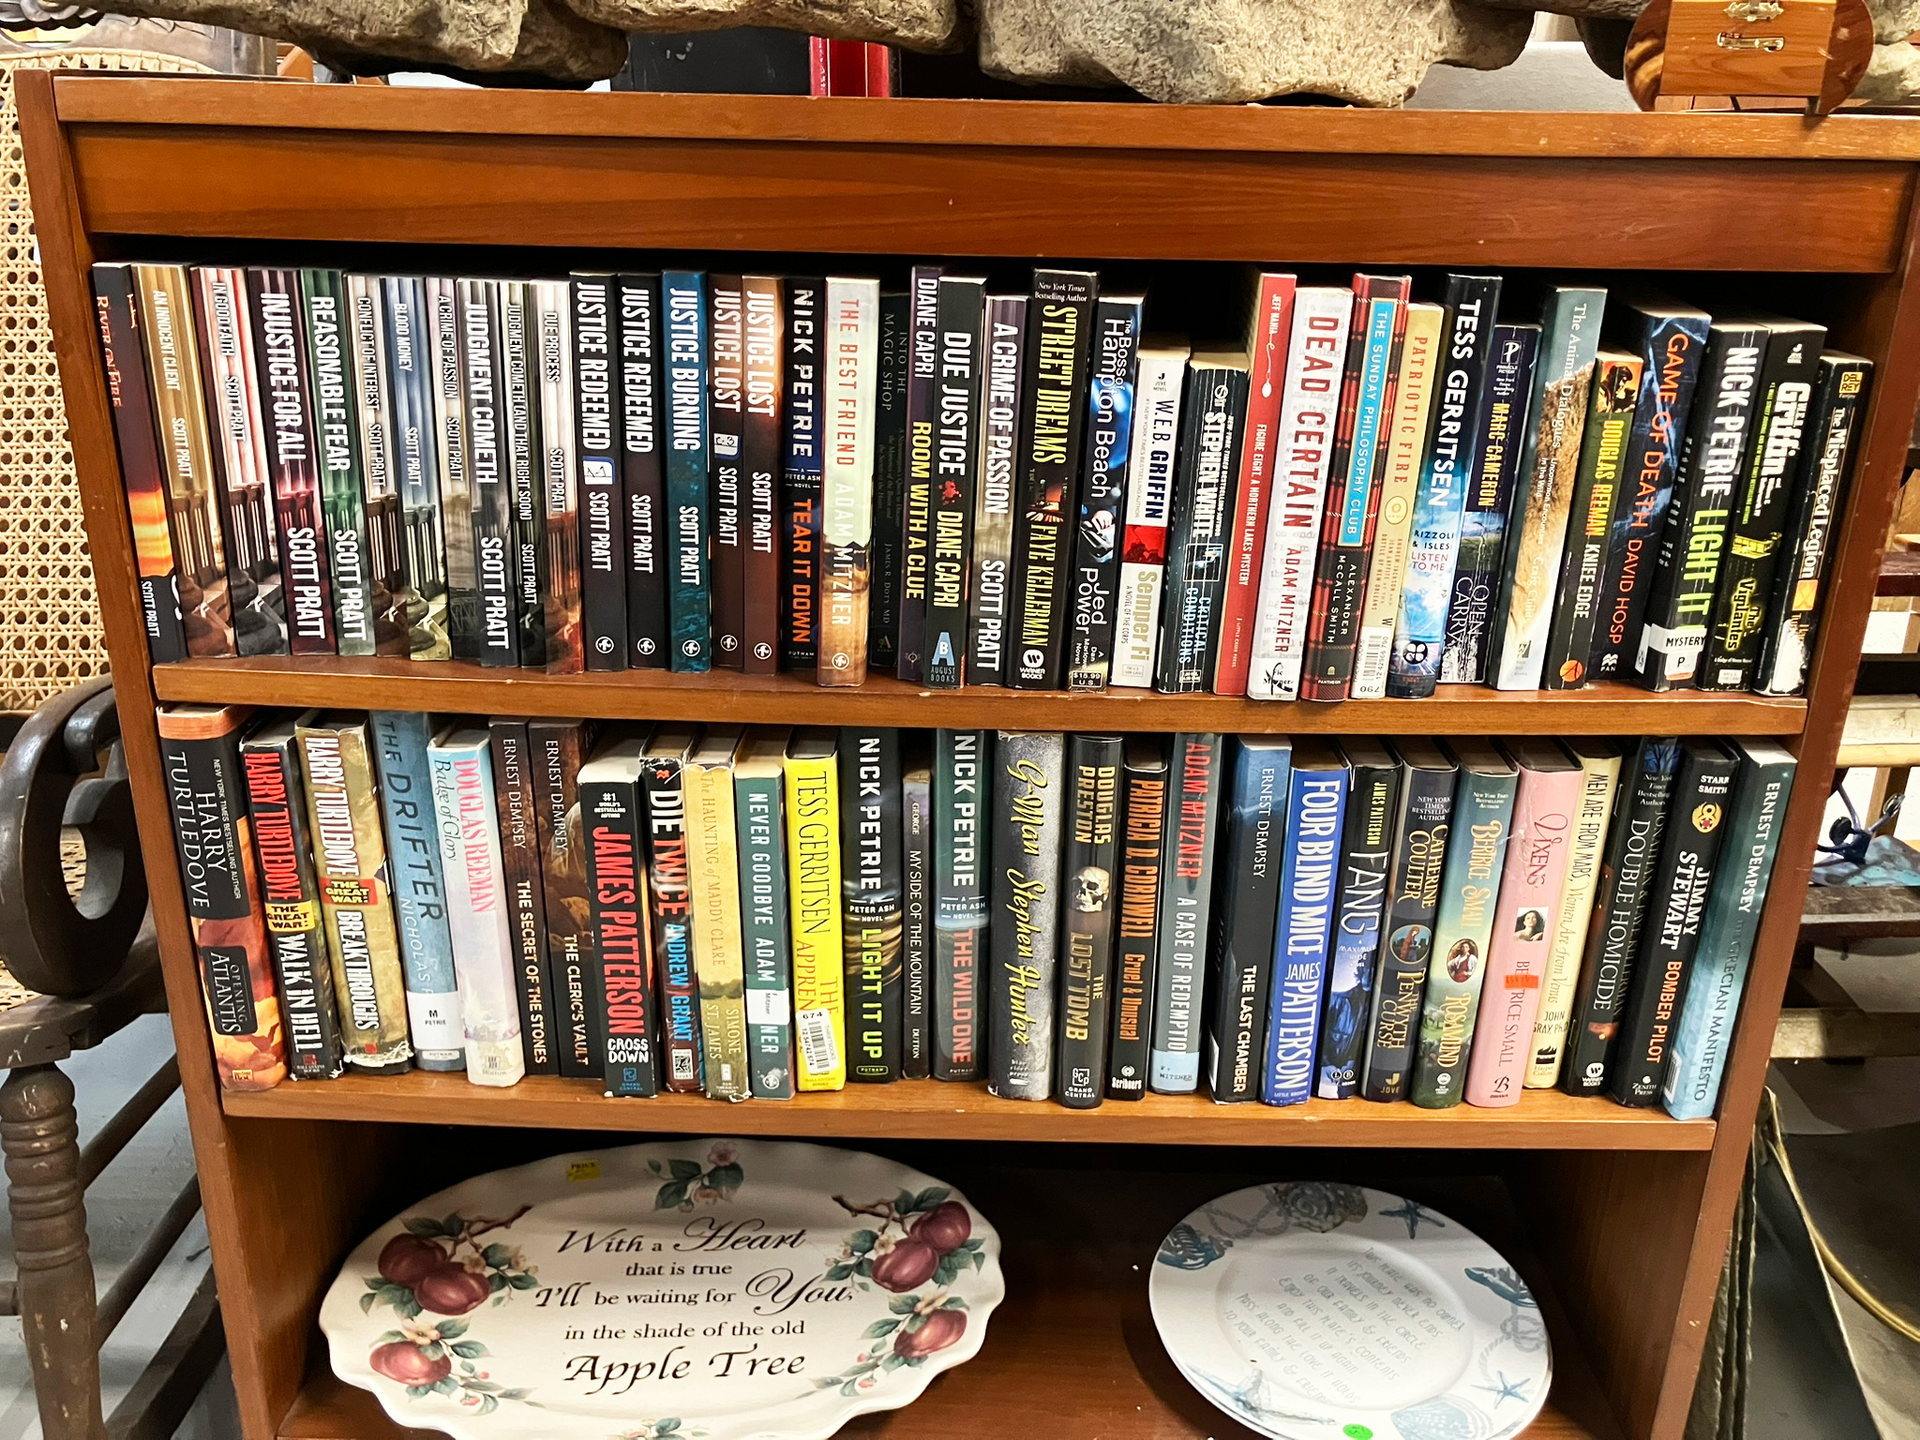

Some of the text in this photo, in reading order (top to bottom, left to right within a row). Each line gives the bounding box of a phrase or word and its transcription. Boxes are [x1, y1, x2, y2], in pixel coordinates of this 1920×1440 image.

[212, 282, 235, 356] IN GOOD FAITH
[394, 303, 413, 372] BLOOD MONEY
[544, 312, 561, 383] DUE PROCESS
[224, 375, 245, 442] SCOTT PRATT
[260, 293, 306, 464] INJUSTICE FOR ALL
[311, 296, 351, 471] REASONABLE FEAR
[622, 287, 653, 452] JUSTICE REDEEMED
[793, 289, 814, 458] NICK PETRIE
[836, 298, 859, 465] THE BEST FRIEND
[939, 332, 971, 475] DUE JUSTICE
[1032, 304, 1078, 464] STREET DREAMS
[1090, 318, 1121, 498] Hampton Beach
[1394, 336, 1428, 484] PATRIOTIC FIRE
[1429, 299, 1482, 506] TESS GERRITSEN
[1145, 400, 1174, 519] W.E.B. GRIFFIN
[1254, 424, 1267, 451] FIGURE
[1283, 317, 1339, 529] DEAD CERTAIN
[1347, 311, 1387, 535] THE SUNDAY PHILOSOPHY CLUB
[1246, 487, 1259, 526] NORTHERN
[1585, 419, 1624, 537] DOUGLAS REEMAN
[1802, 407, 1846, 578] The Misplaced Legion
[631, 494, 653, 573] SCOTT PRATT
[1239, 554, 1252, 585] MYSTERY
[1242, 529, 1255, 551] LAKES
[1574, 544, 1600, 618] KNIFE EDGE
[1021, 525, 1056, 646] FAYE KELLERMAN
[1076, 567, 1099, 635] Power
[1092, 583, 1110, 625] Jed
[1326, 607, 1341, 645] SMITH
[1341, 564, 1358, 636] ALEXANDER
[1727, 580, 1755, 650] Vigilantes
[1666, 637, 1706, 648] MYSTERY
[168, 751, 209, 908] TURTLEDOVE
[195, 791, 227, 872] HARRY
[379, 721, 444, 921] THE DRIFTER
[454, 760, 496, 913] DOUGLAS REEMAN
[503, 739, 525, 849] ERNEST DEMPSEY
[859, 738, 881, 890] NICK PETRIE
[912, 803, 920, 834] GEORGE
[1007, 760, 1048, 856] G-Man
[1568, 773, 1609, 882] MEN ARE FROM MARS,
[748, 793, 774, 925] NEVER GOODBYE
[797, 771, 831, 934] TESS GERRITSEN
[1121, 779, 1164, 938] PATRICIA D. CORNWELL
[1286, 780, 1341, 956] FOUR BLIND MICE
[1341, 852, 1388, 934] FANG
[1396, 830, 1429, 903] COULTER
[1420, 824, 1448, 909] CATHERINE
[1659, 851, 1699, 950] STEWART
[1682, 866, 1711, 937] JIMMY
[278, 934, 308, 985] WALK
[593, 826, 645, 1035] JAMES PATTERSON
[909, 850, 922, 1015] MY SIDE OF THE MOUNTAIN
[1004, 868, 1047, 1045] Stephen Hunter
[1593, 819, 1650, 1010] DOUBLE HOMICIDE
[210, 952, 240, 1033] ATLANTIS
[231, 965, 247, 1022] OPENING
[286, 989, 315, 1007] IN
[336, 911, 379, 1030] BREAKTHROUGHS
[564, 934, 578, 961] THE
[573, 1025, 588, 1065] VAULT
[665, 923, 692, 1041] ANDREW GRANT
[862, 929, 882, 1059] LIGHT IT UP
[1066, 932, 1093, 1041] LOST TOMB
[290, 1014, 323, 1052] HELL
[607, 1038, 648, 1050] CROSS
[608, 1050, 648, 1064] DOWN
[825, 1025, 836, 1060] THRIFTBOOKS
[912, 1028, 920, 1059] DUTTON
[1233, 965, 1257, 1092] THE LAST CHAMBER
[1693, 942, 1743, 1102] GRECIAN MANIFESTO
[557, 1217, 807, 1254] With a Heart
[626, 1262, 733, 1277] that is true
[565, 1320, 805, 1339] in the shade of the old
[595, 1292, 619, 1305] be
[626, 1288, 699, 1308] waiting
[704, 1288, 736, 1304] for
[564, 1343, 806, 1395] Apple Tree
